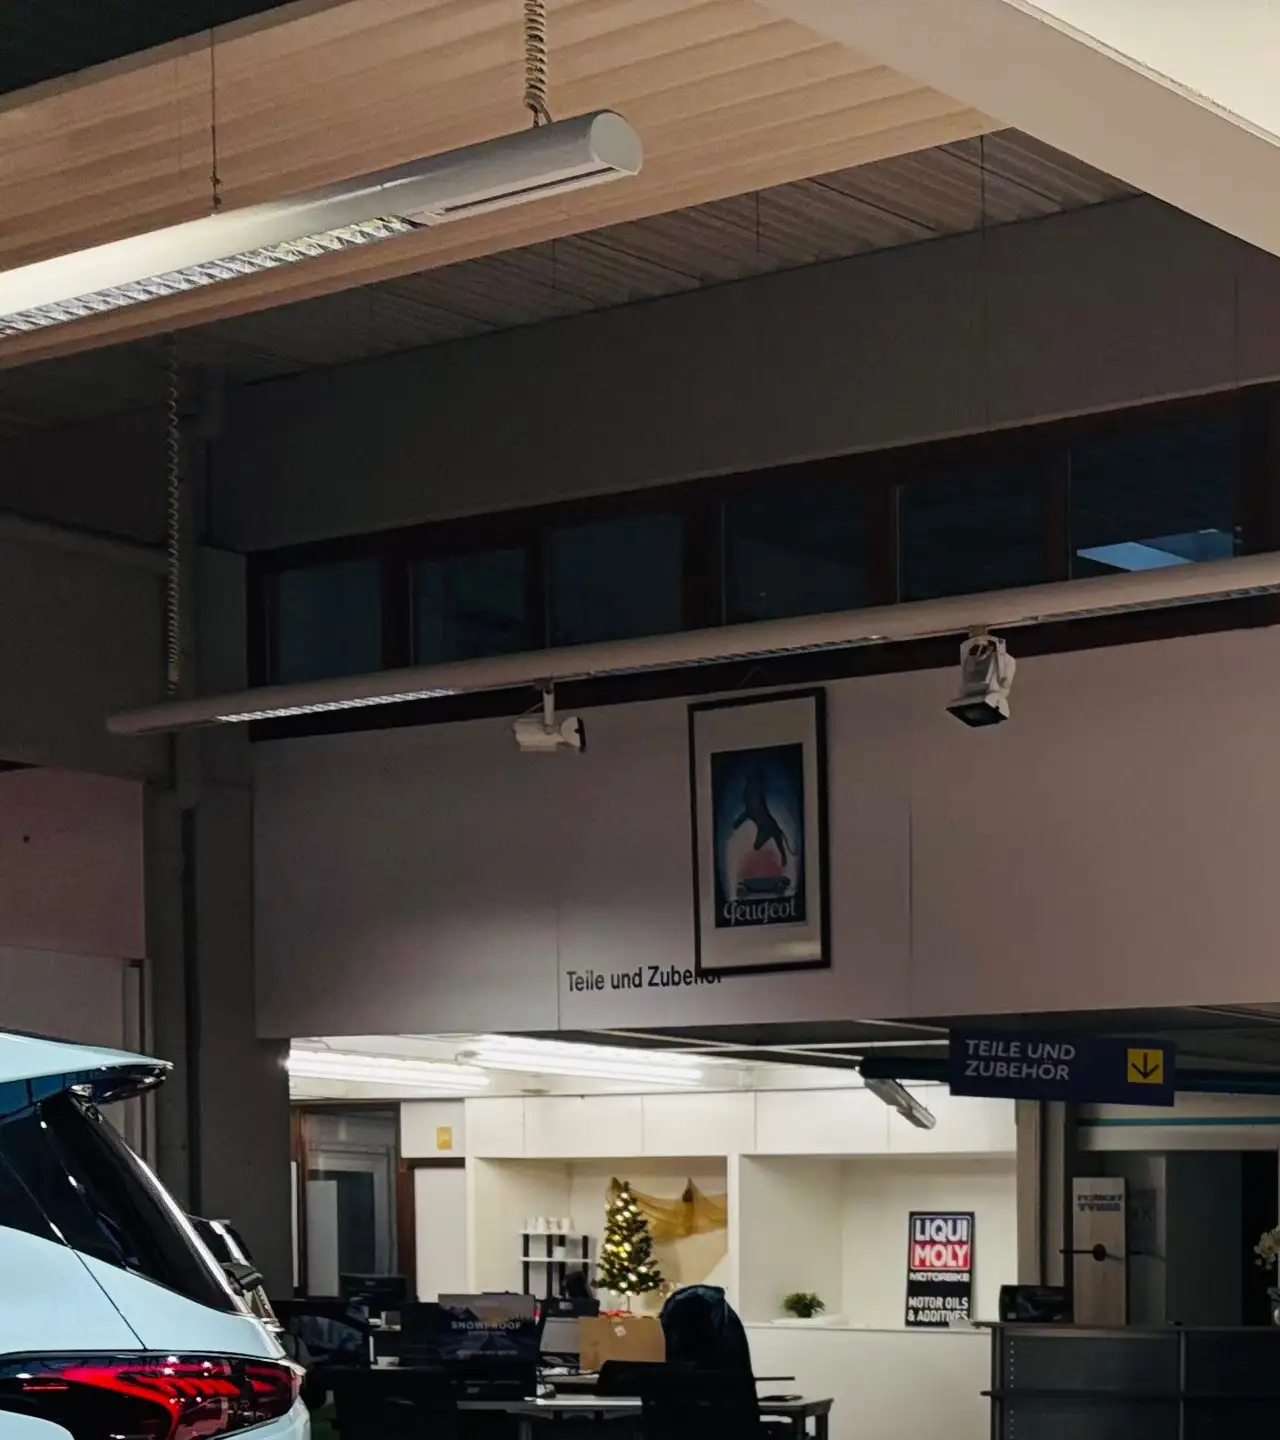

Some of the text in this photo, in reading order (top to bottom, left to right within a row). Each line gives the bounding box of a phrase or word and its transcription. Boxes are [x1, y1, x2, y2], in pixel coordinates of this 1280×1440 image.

[566, 970, 605, 993] Teile
[610, 966, 643, 990] und
[964, 1039, 1076, 1060] TEILE UND
[964, 1060, 1069, 1081] ZUBEHÖR
[914, 1219, 968, 1243] LIQUI
[913, 1243, 968, 1267] MOLY
[909, 1271, 970, 1282] MOTORBIKE
[908, 1296, 969, 1310] MOTOR OILS
[907, 1309, 969, 1322] & ADDITIVES
